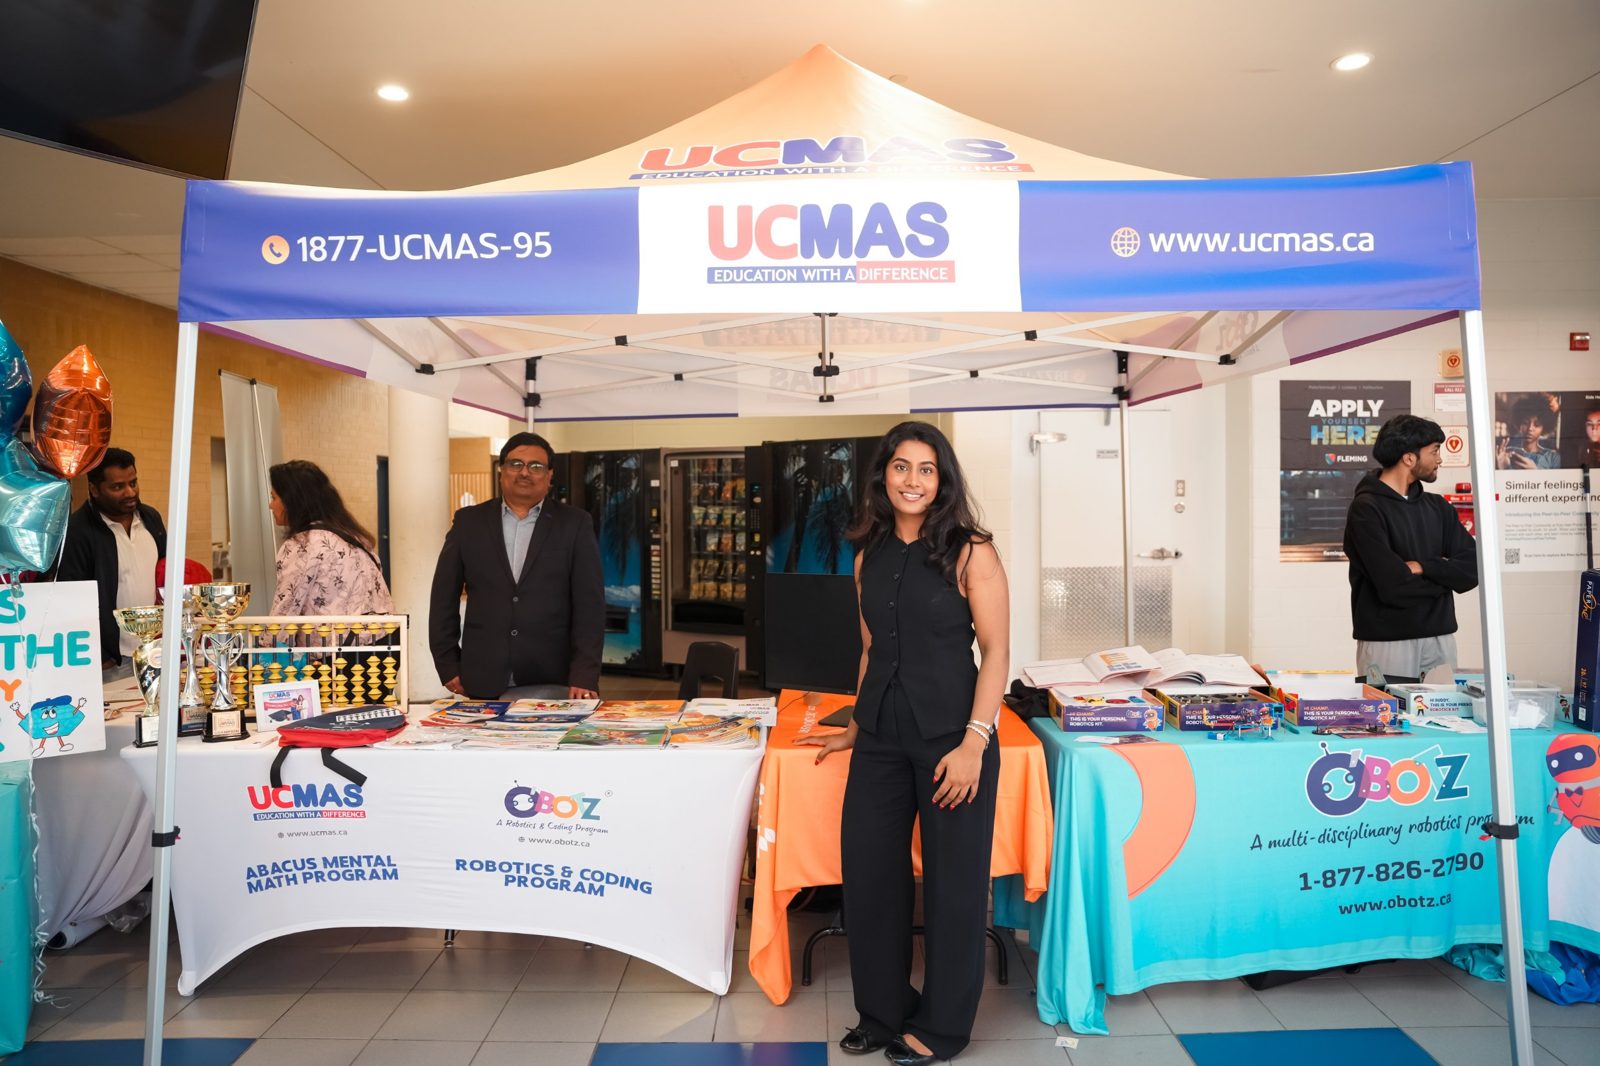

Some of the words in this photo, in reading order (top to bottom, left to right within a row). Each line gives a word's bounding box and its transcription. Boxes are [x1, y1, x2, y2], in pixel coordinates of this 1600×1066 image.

[640, 136, 1017, 171] UCMAS
[640, 168, 775, 179] EDUCATION
[783, 166, 846, 175] WITH
[707, 202, 950, 260] UCMAS
[1149, 231, 1375, 253] www.ucmas.ca
[296, 231, 552, 262] 1877-UCMAS-95
[713, 268, 798, 283] EDUCATION
[801, 267, 843, 281] WITH
[844, 267, 856, 281] A
[859, 267, 949, 281] DIFFERENCE
[1308, 400, 1384, 417] APPLY
[1310, 425, 1381, 445] HERE
[1505, 481, 1541, 490] Similar
[1544, 480, 1585, 491] feelings
[1505, 494, 1549, 503] different
[0, 589, 26, 624] S
[0, 631, 91, 671] THE
[0, 679, 22, 702] Y
[247, 783, 365, 810] UCMAS
[256, 811, 296, 820] EDUCATION
[322, 810, 365, 818] DIFFERENCE
[287, 829, 348, 838] www.ucmas.ca
[505, 820, 537, 829] Robotics
[547, 822, 573, 834] Coding
[575, 823, 609, 836] Program
[1250, 833, 1263, 851] A
[1268, 822, 1402, 848] multi-disciplinary
[1408, 814, 1463, 833] robotics
[528, 837, 591, 848] www.obotz.ca
[246, 857, 317, 880] ABACUS
[321, 855, 397, 869] MENTAL
[455, 859, 555, 876] ROBOTICS
[560, 866, 573, 878] &
[579, 868, 653, 895] CODING
[1299, 852, 1484, 892] 1-877-826-2790
[246, 873, 299, 894] MATH
[302, 868, 399, 884] PROGRAM
[504, 874, 605, 897] PROGRAM
[1338, 892, 1452, 915] www.obotz.ca
